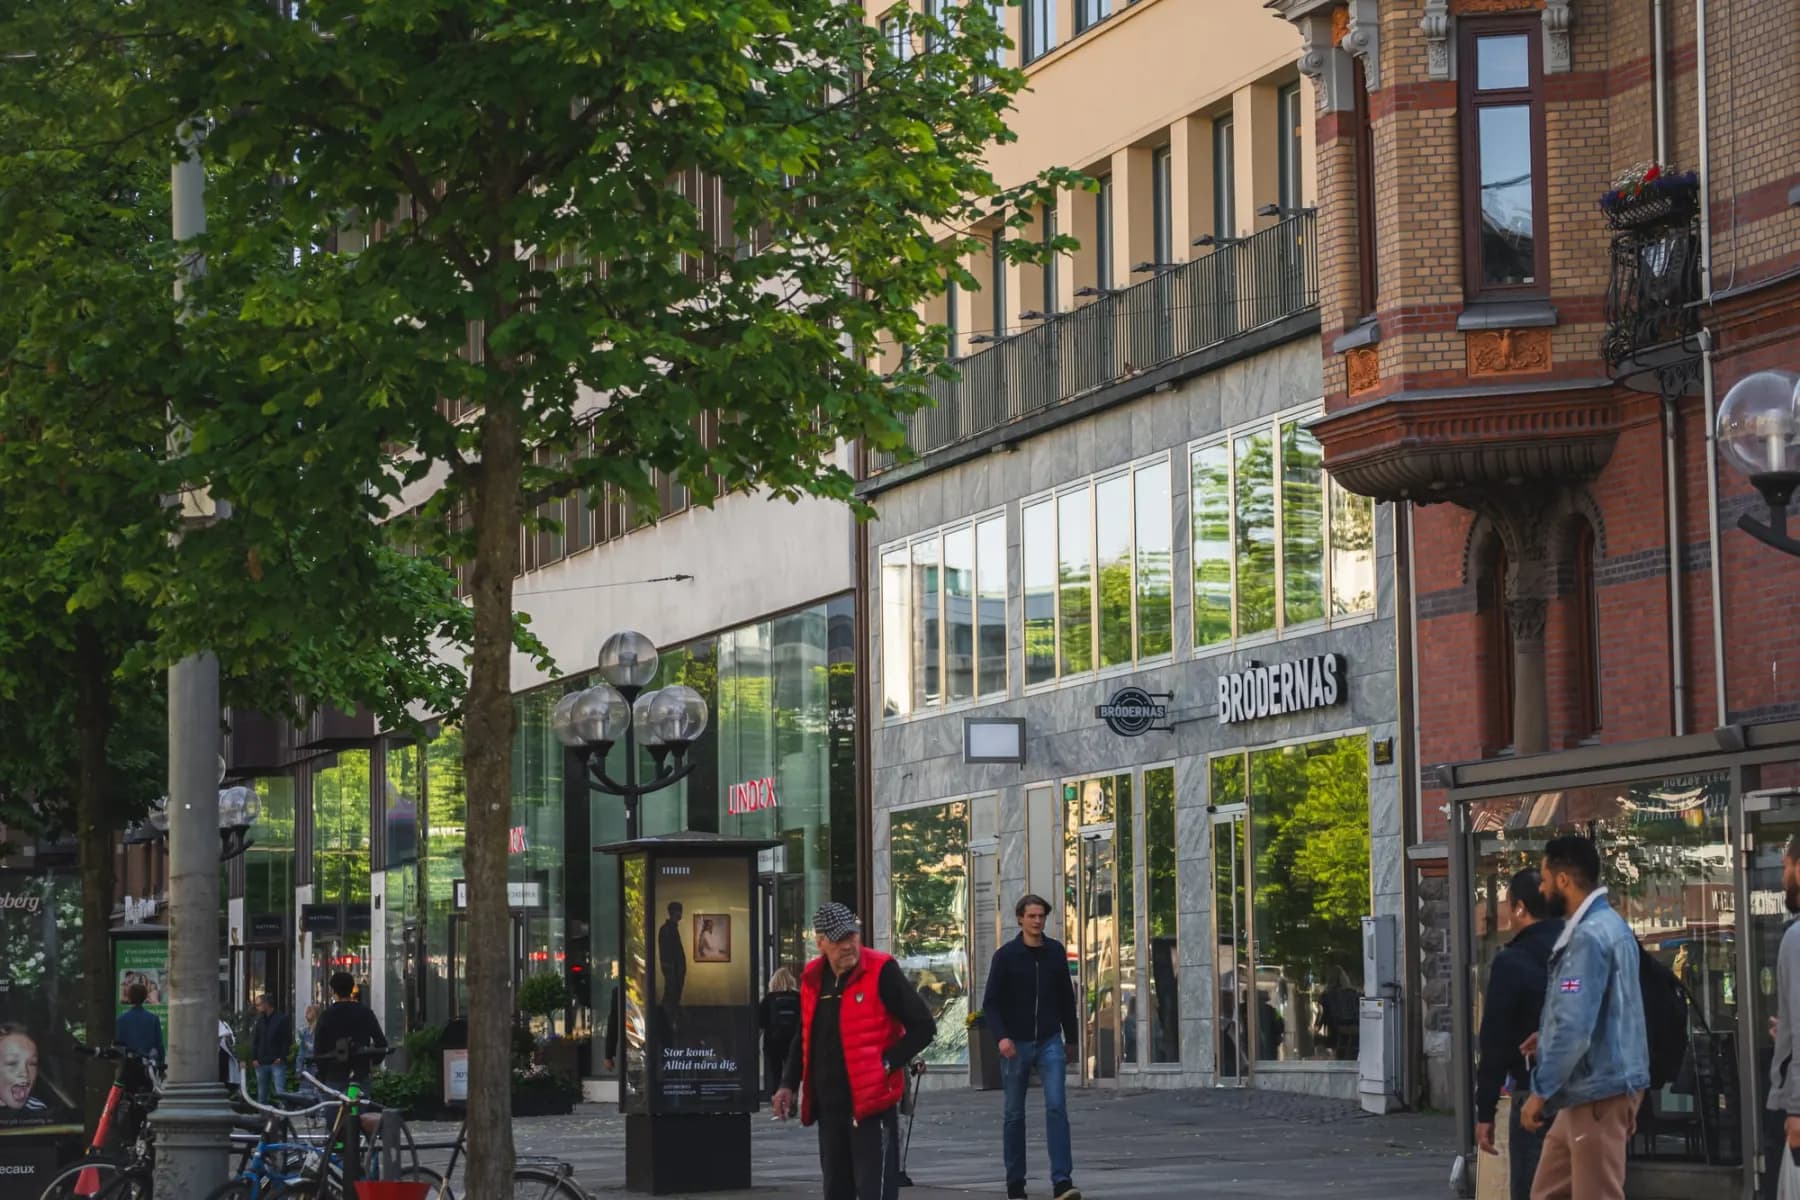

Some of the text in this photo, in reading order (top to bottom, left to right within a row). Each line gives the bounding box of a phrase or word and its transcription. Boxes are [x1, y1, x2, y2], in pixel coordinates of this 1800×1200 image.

[1218, 653, 1337, 724] BRÖDERNAS
[1101, 705, 1164, 718] BRÖDERNAS
[727, 777, 777, 814] LINDEX
[663, 1047, 717, 1057] Stor konst.
[663, 1059, 737, 1072] Alltid nära dig.
